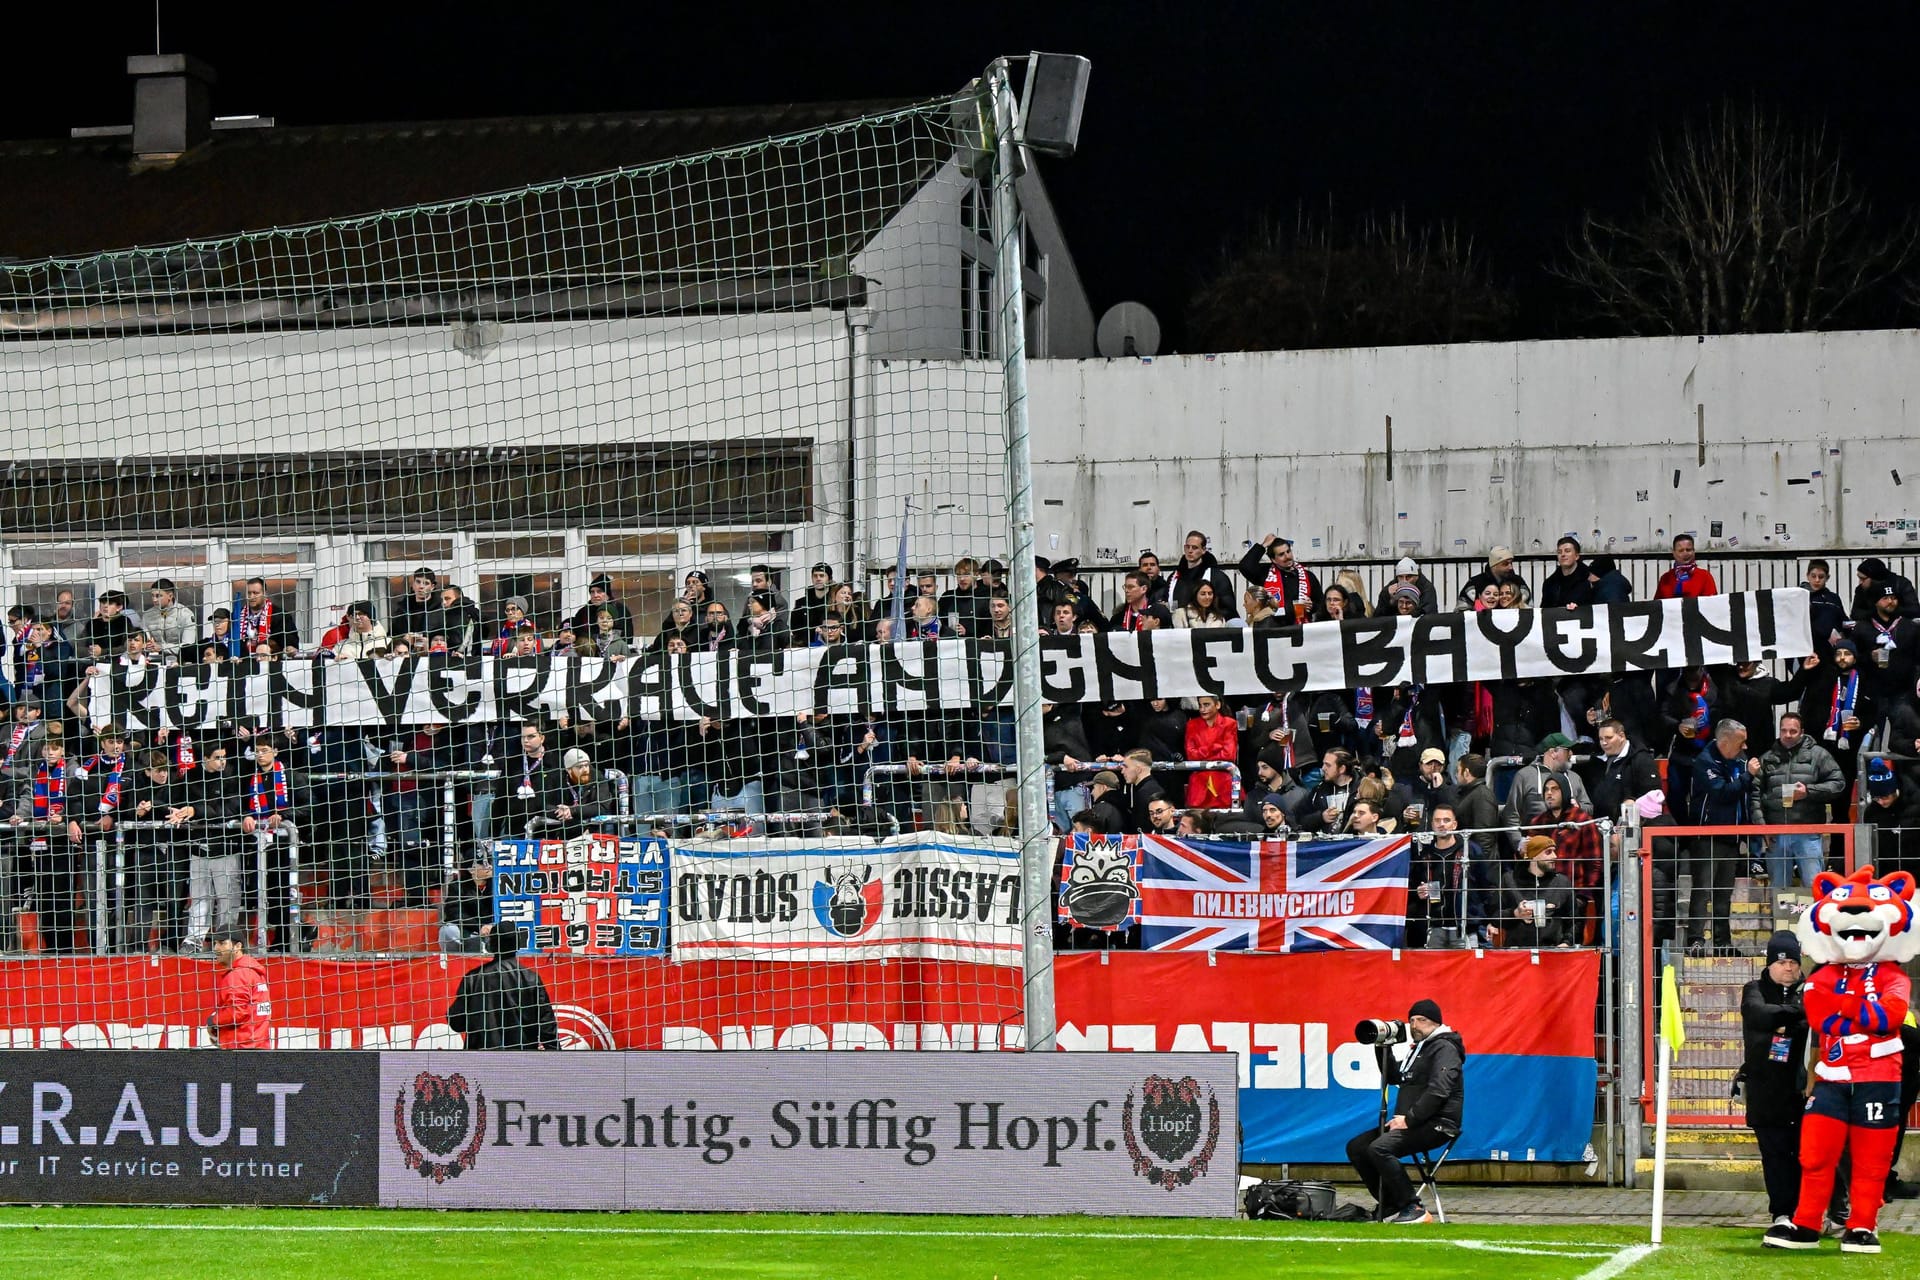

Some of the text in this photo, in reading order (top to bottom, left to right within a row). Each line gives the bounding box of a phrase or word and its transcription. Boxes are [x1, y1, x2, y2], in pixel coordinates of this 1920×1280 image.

[814, 641, 940, 718] AN
[966, 632, 1158, 710] DEN
[1192, 623, 1308, 698] FC
[1341, 589, 1777, 689] BAYERN!
[495, 840, 664, 868] VERBOTE
[498, 870, 664, 896] STADION
[678, 867, 1021, 924] LASSIC SQUAD
[499, 898, 661, 922] ALLE
[420, 1110, 463, 1132] Hopf
[1865, 1102, 1884, 1121] 12
[492, 1098, 1117, 1168] Fruchtig. Süffig Hopf.
[1149, 1115, 1194, 1136] Hopf
[39, 1156, 61, 1176] IT
[81, 1157, 179, 1177] Service
[202, 1157, 304, 1178] Partner
